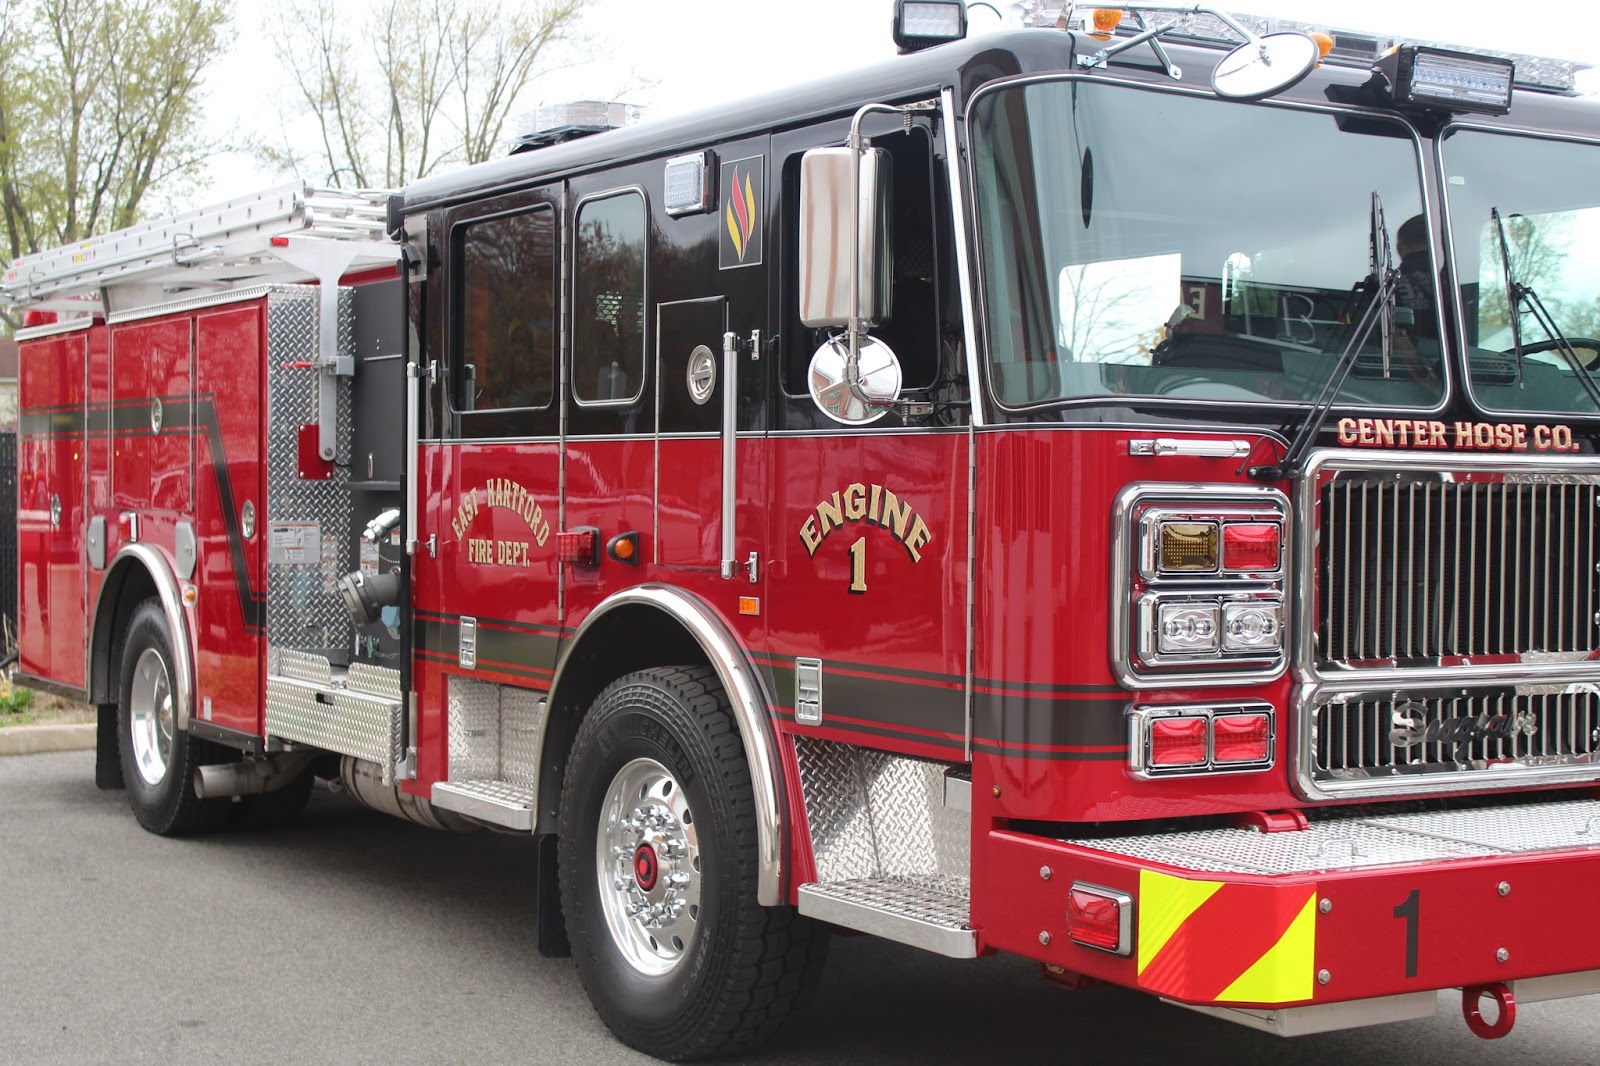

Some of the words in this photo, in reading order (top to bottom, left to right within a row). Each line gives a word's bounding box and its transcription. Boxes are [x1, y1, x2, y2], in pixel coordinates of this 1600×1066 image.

[1338, 418, 1448, 448] CENTER
[1454, 421, 1527, 450] HOSE
[1533, 424, 1580, 452] CO.
[451, 487, 479, 542] EAST
[486, 478, 549, 547] HARTFORD
[799, 483, 932, 563] ENGINE
[468, 538, 493, 564] FIRE
[497, 540, 530, 567] DEPT.
[848, 536, 867, 594] 1
[1393, 888, 1420, 977] 1
